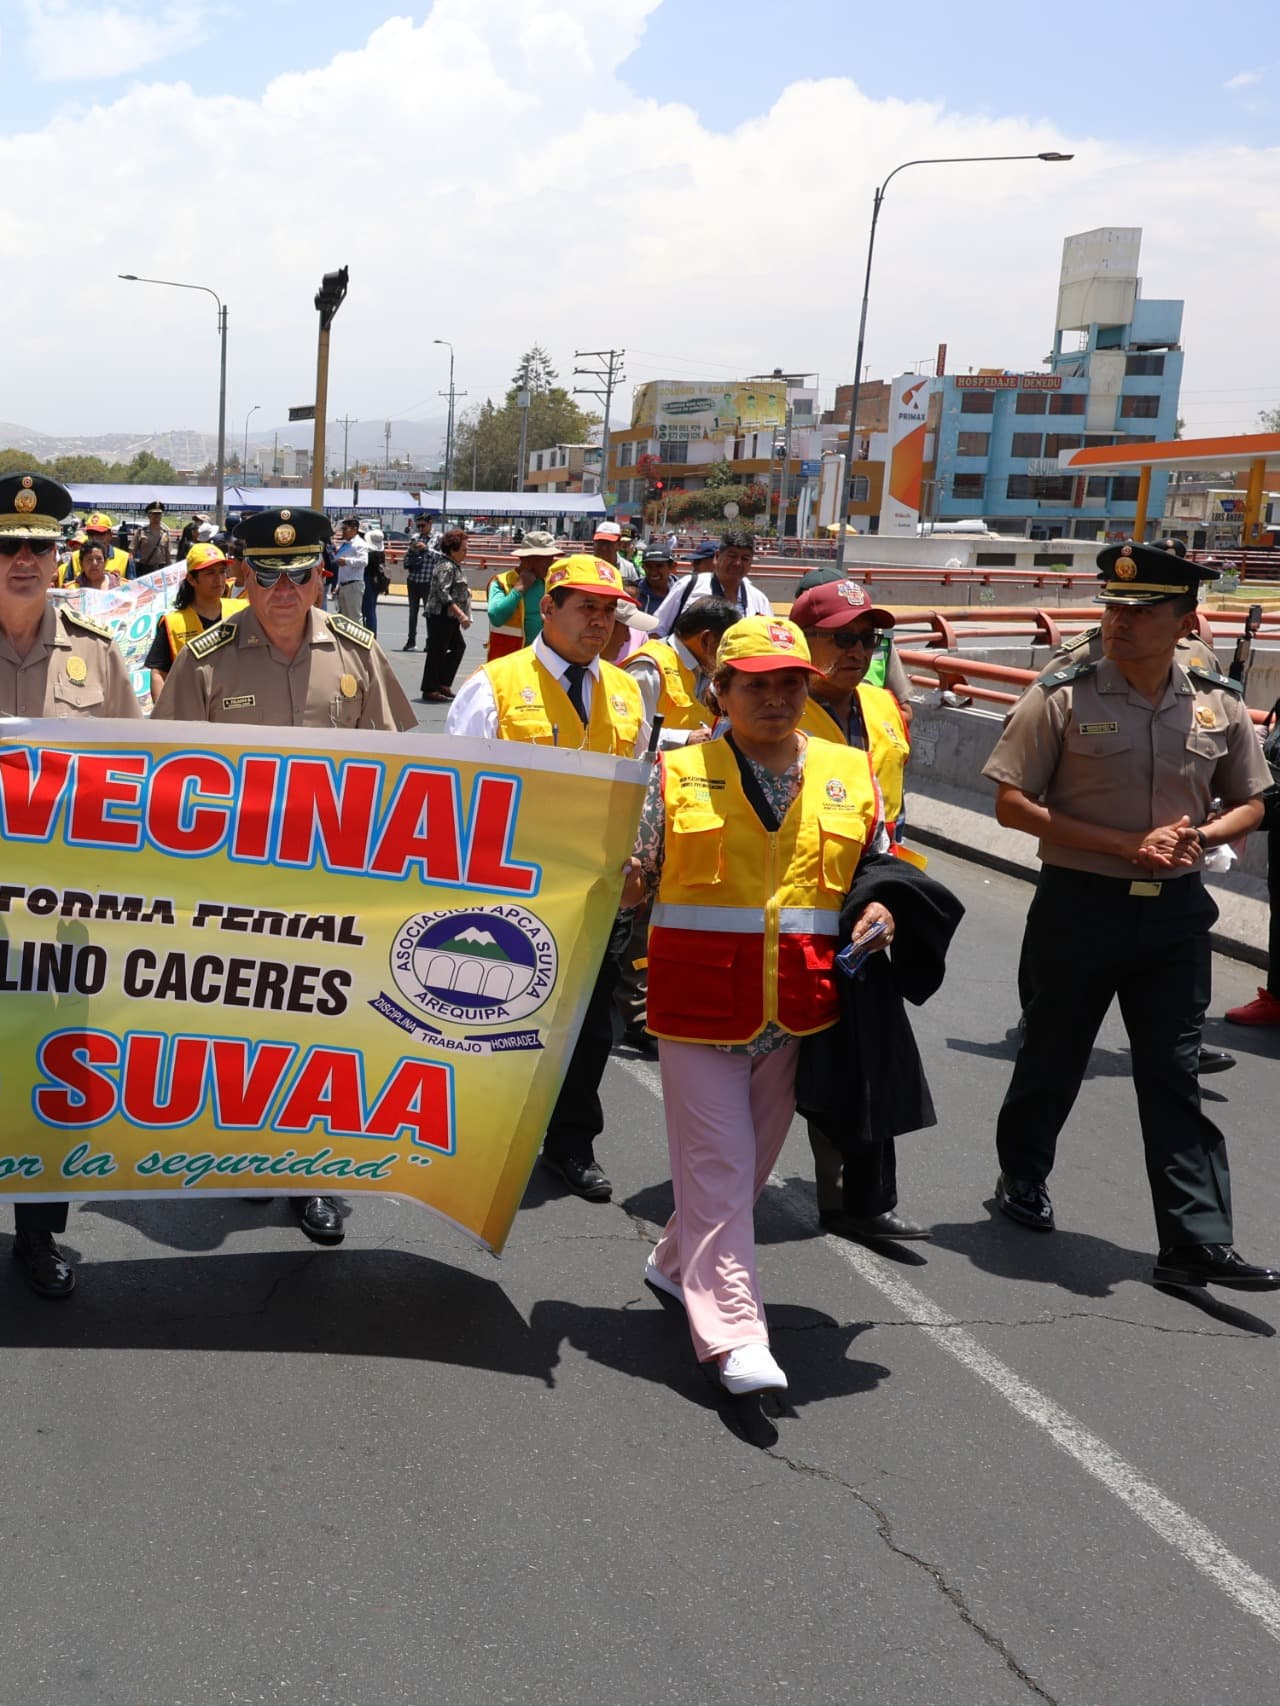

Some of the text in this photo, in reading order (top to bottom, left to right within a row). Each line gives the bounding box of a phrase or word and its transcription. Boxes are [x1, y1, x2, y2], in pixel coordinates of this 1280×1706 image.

[957, 376, 1018, 388] HOSPEDAJE
[898, 412, 926, 421] PRIMAX
[489, 905, 541, 939] APCA
[526, 941, 553, 999] SUVAA
[122, 948, 353, 1017] CACERES
[374, 998, 540, 1053] DISCIPLINA TRABAJO HONRADEZ
[414, 991, 510, 1021] AREQUIPA
[32, 1027, 455, 1157] SUVAA
[61, 1143, 116, 1176] la
